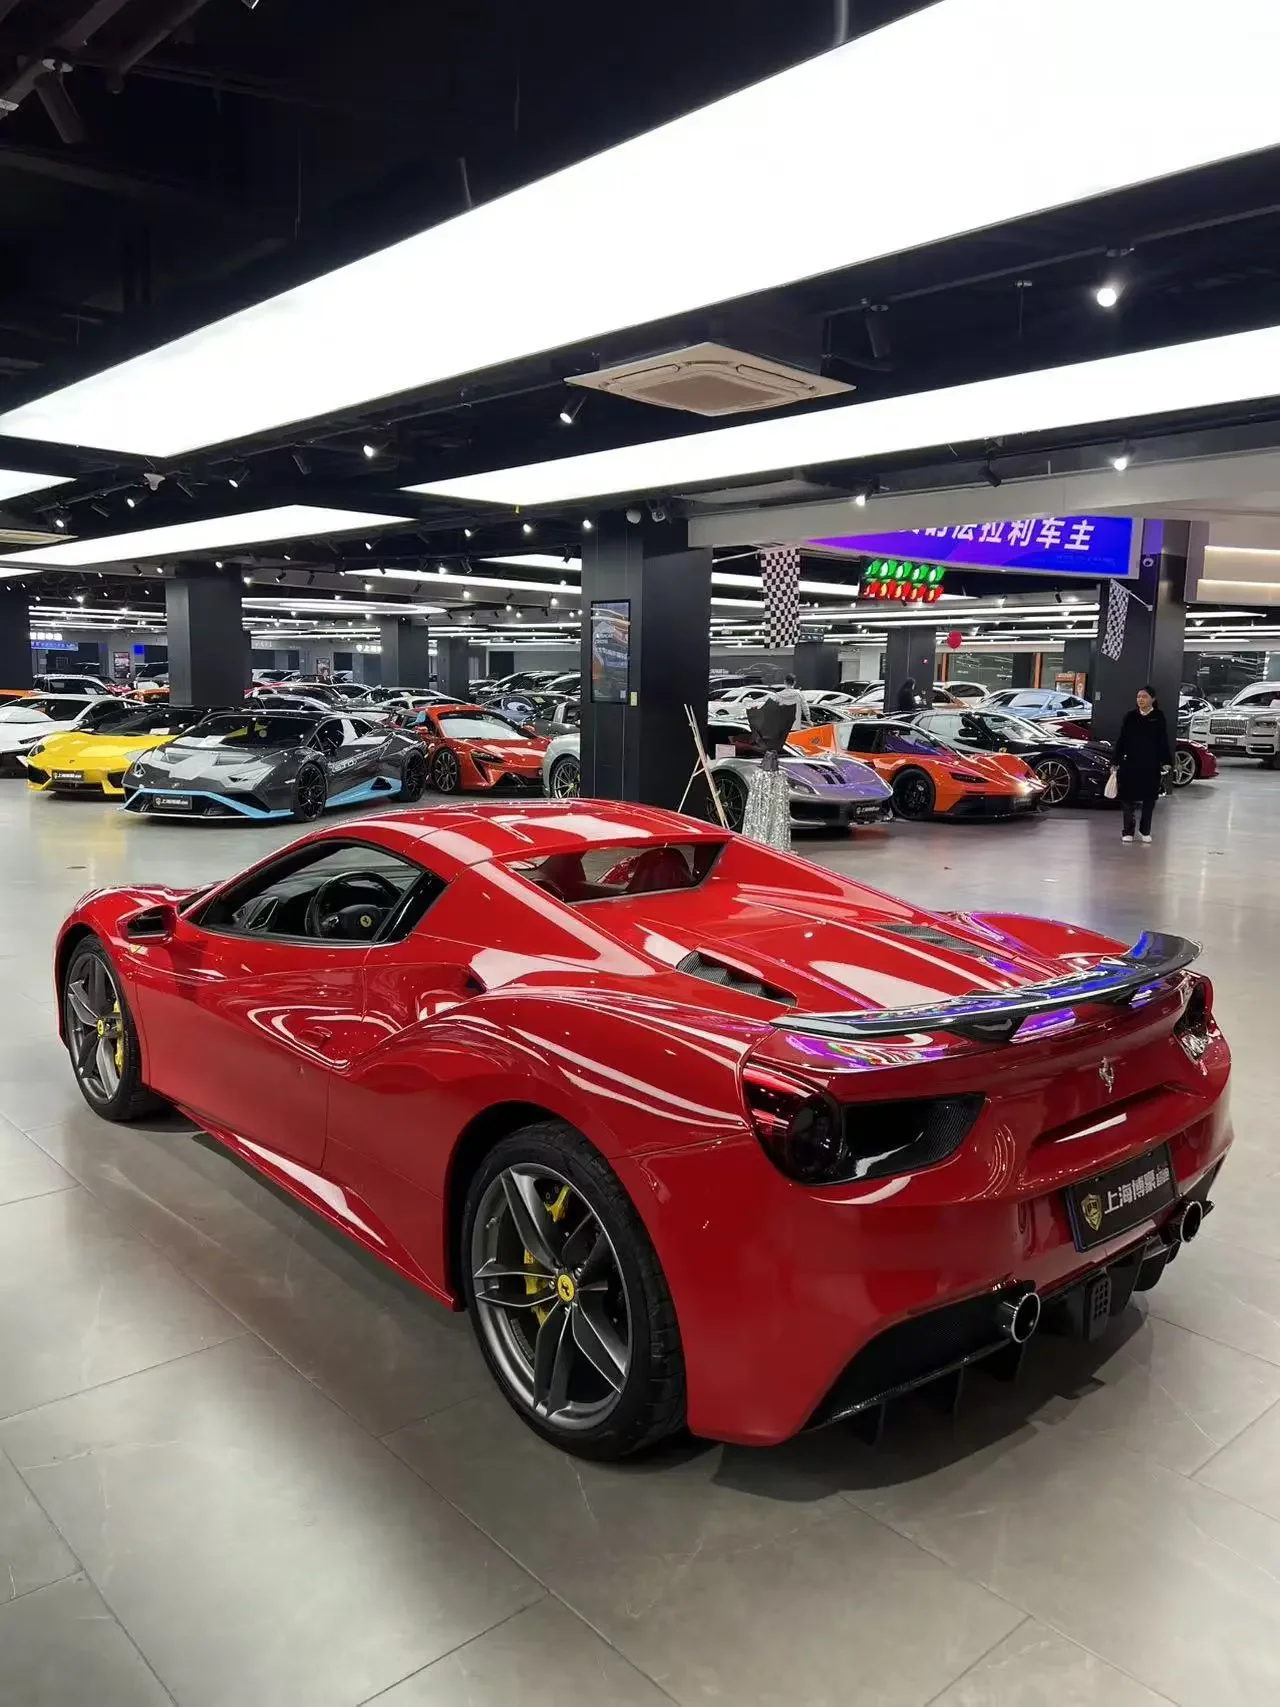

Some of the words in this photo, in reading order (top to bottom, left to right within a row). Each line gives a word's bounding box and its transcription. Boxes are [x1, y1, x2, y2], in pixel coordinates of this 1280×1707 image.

[899, 517, 1095, 551] 法拉利车主
